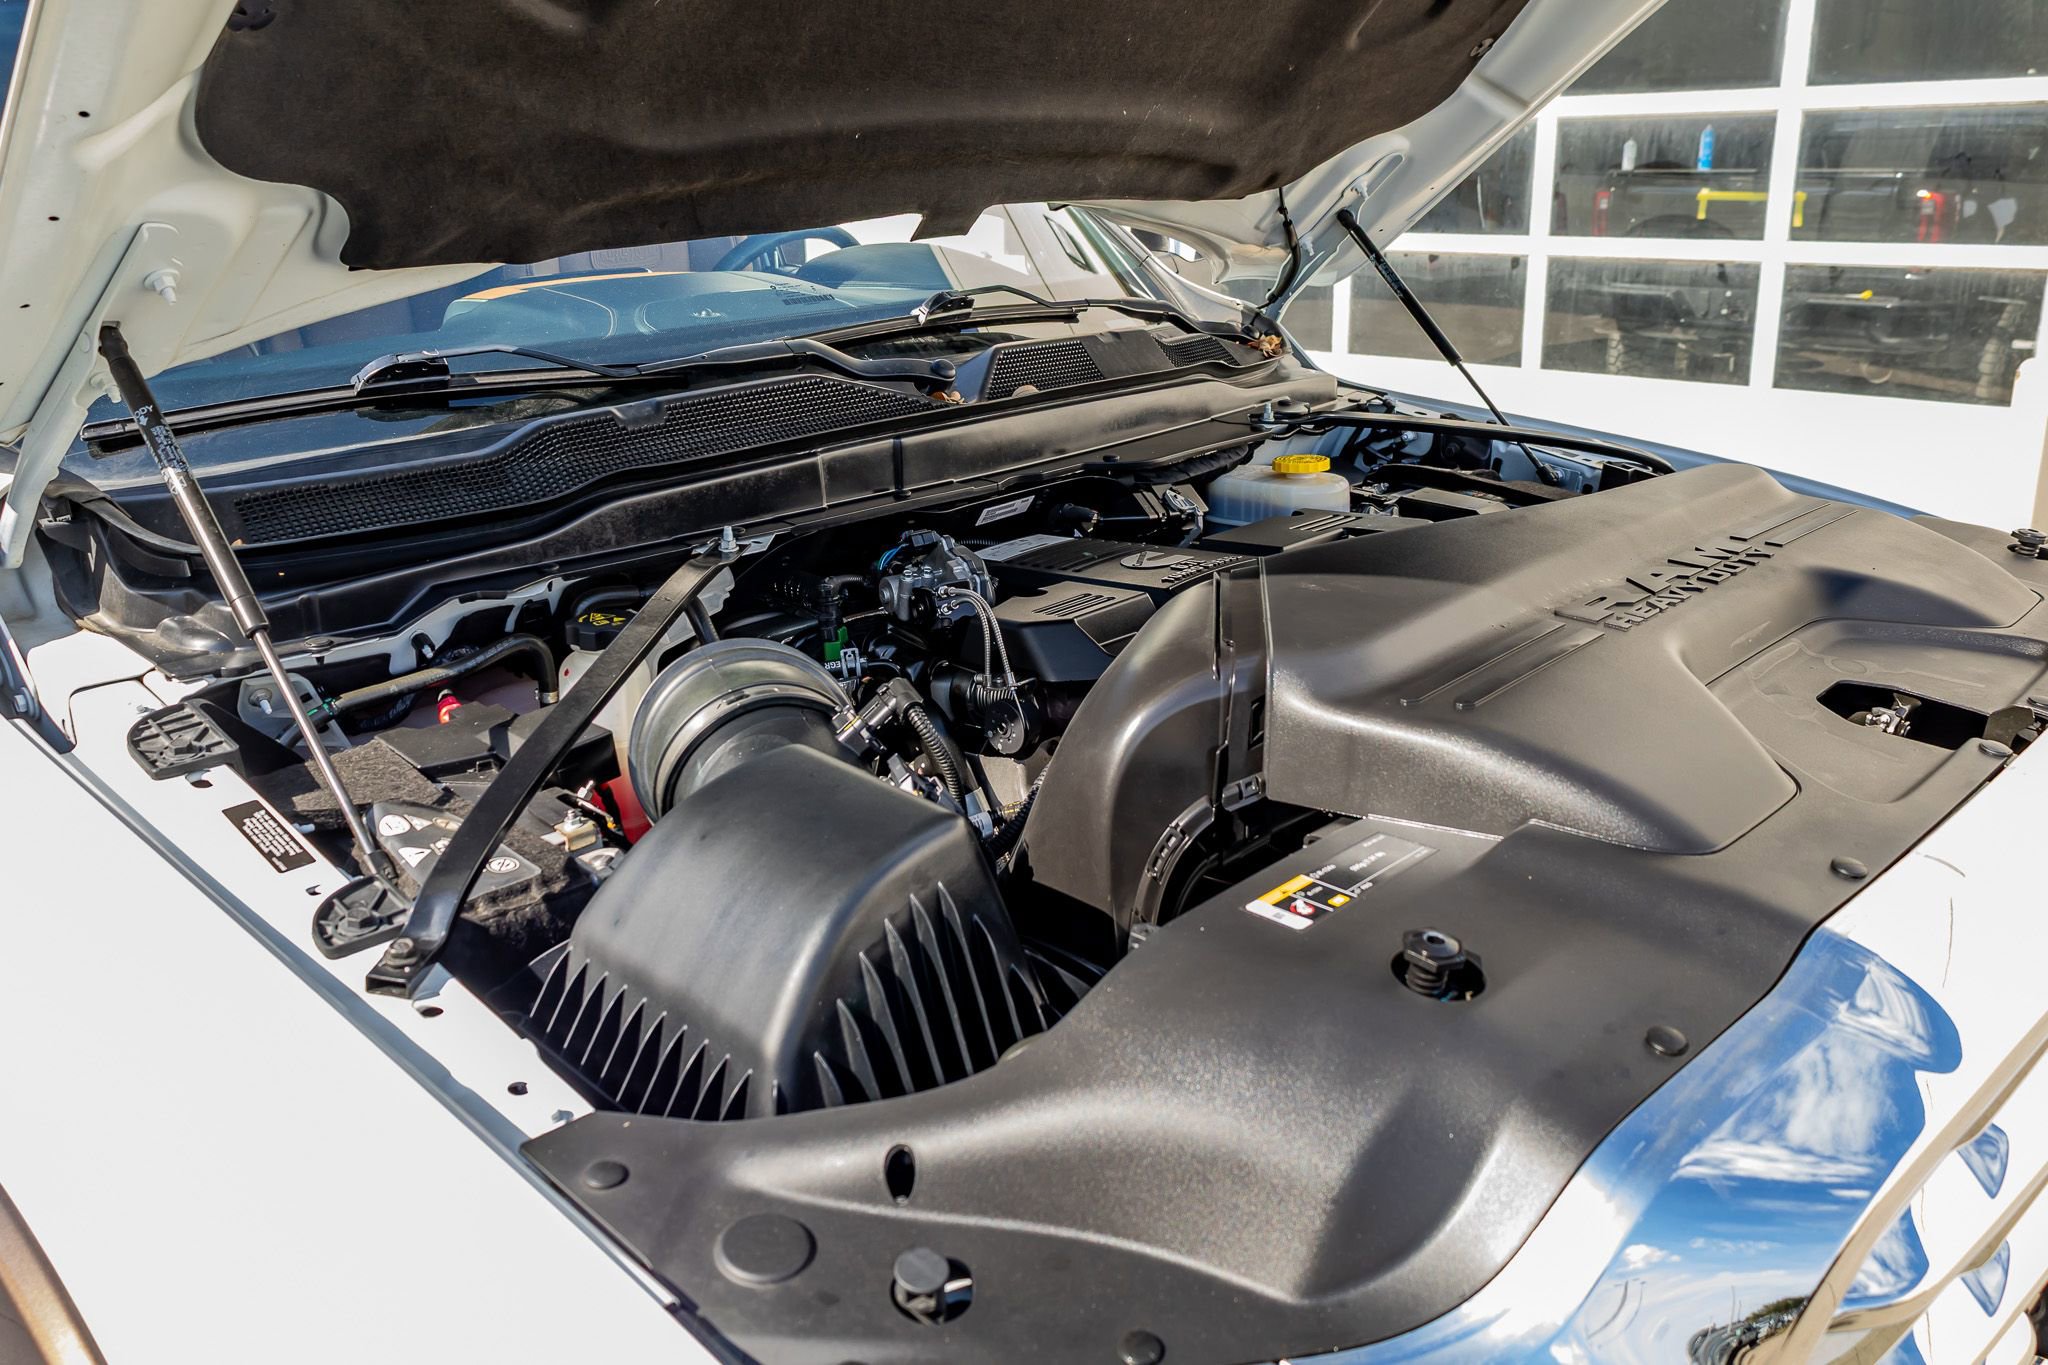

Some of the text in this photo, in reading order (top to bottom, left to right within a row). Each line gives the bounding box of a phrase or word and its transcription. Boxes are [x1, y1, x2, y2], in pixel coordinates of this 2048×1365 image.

[134, 404, 153, 419] ODY
[1554, 541, 1752, 624] RAM
[1604, 548, 1775, 632] HEAVY DUTY
[824, 660, 841, 670] EGR
